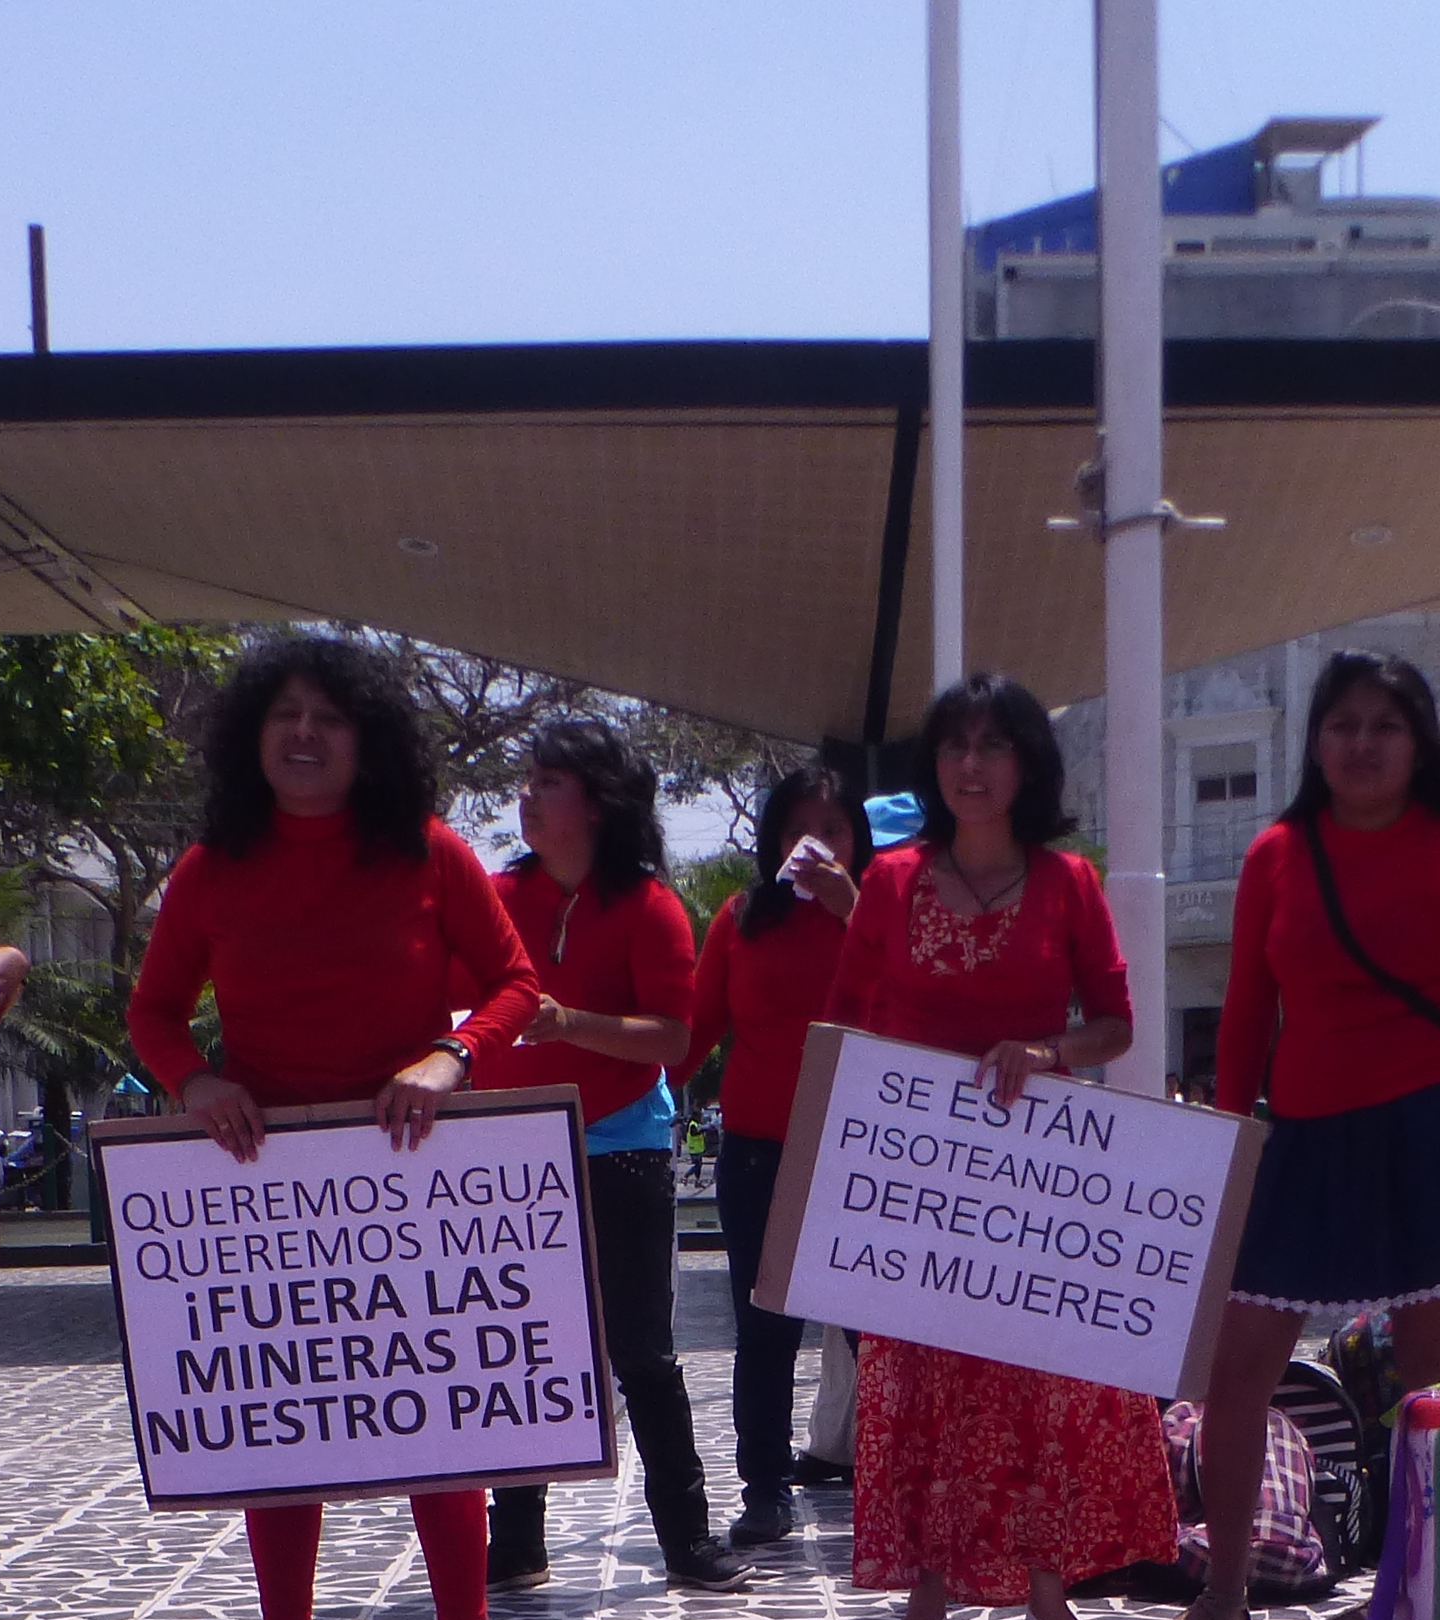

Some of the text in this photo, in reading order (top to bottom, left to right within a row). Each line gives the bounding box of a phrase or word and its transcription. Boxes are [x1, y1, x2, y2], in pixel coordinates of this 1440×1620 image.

[878, 1072, 1115, 1151] SE ESTÁN
[122, 1162, 570, 1234] QUEREMOS AGUA
[839, 1118, 1205, 1227] PISOTEANDO LOS
[136, 1202, 567, 1283] QUEREMOS MAÍZ
[843, 1173, 1194, 1285] DERECHOS DE
[186, 1263, 530, 1340] ¡FUERA LAS
[829, 1237, 1156, 1336] LAS MUJERES
[177, 1321, 552, 1395] MINERAS DE
[146, 1366, 595, 1455] NUESTRO PAÍS!
